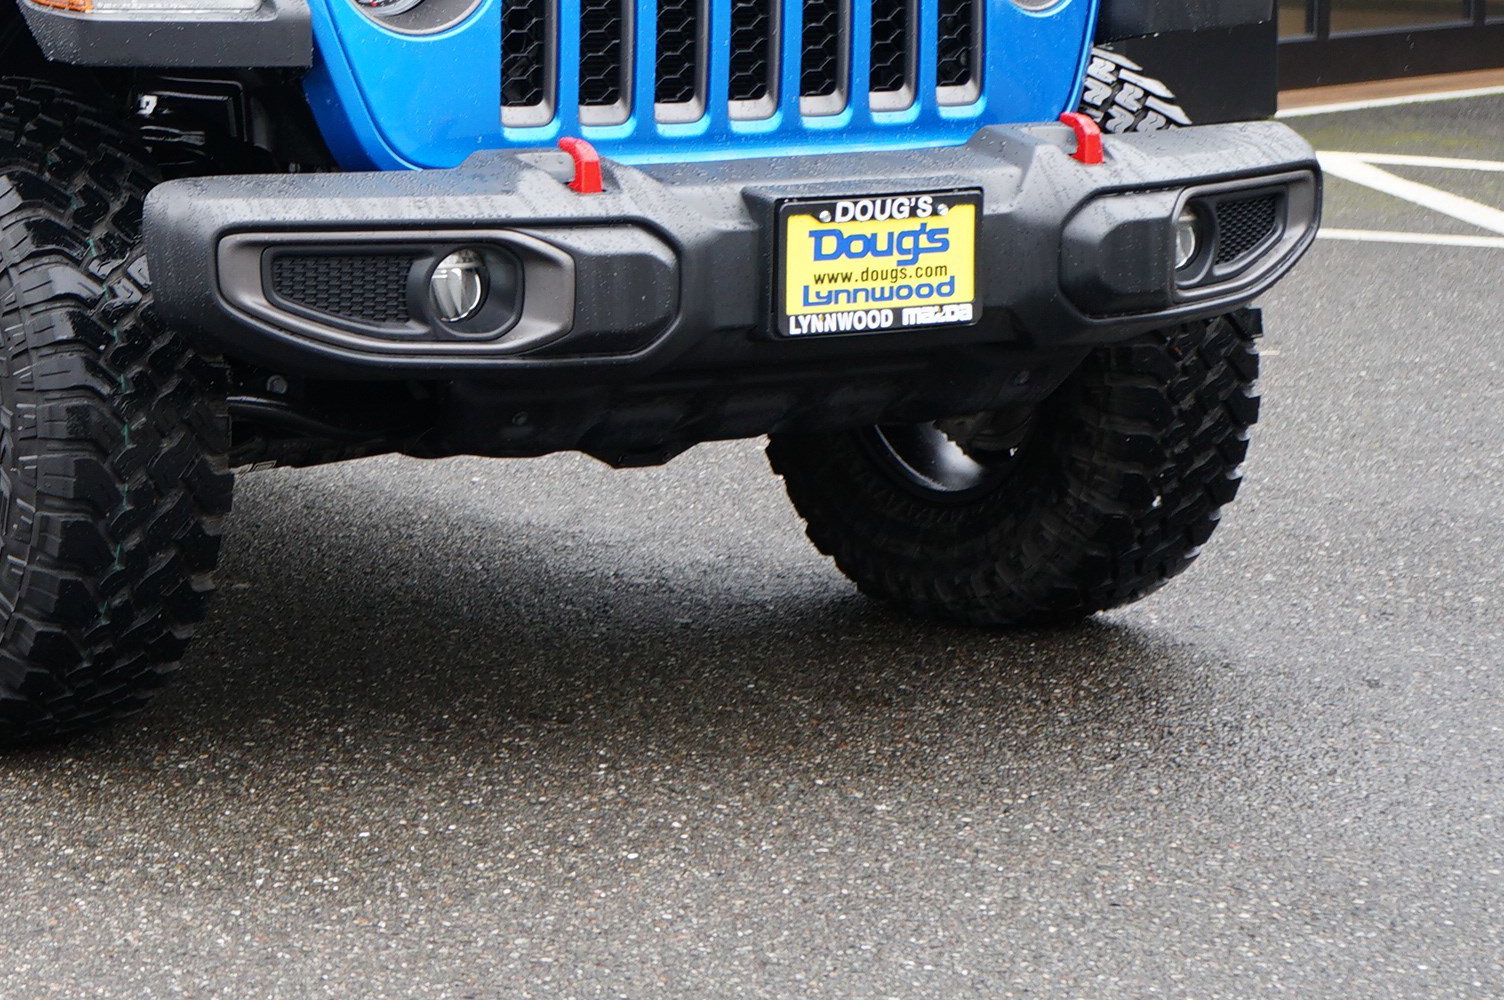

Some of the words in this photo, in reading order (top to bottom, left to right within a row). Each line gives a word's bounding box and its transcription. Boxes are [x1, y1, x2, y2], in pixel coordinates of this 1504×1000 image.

[834, 196, 934, 223] DOUG'S
[808, 222, 950, 267] Doug's
[813, 264, 949, 285] www.dougs.com
[802, 275, 956, 307] Lynnwood
[788, 308, 894, 336] LYNNWOOD
